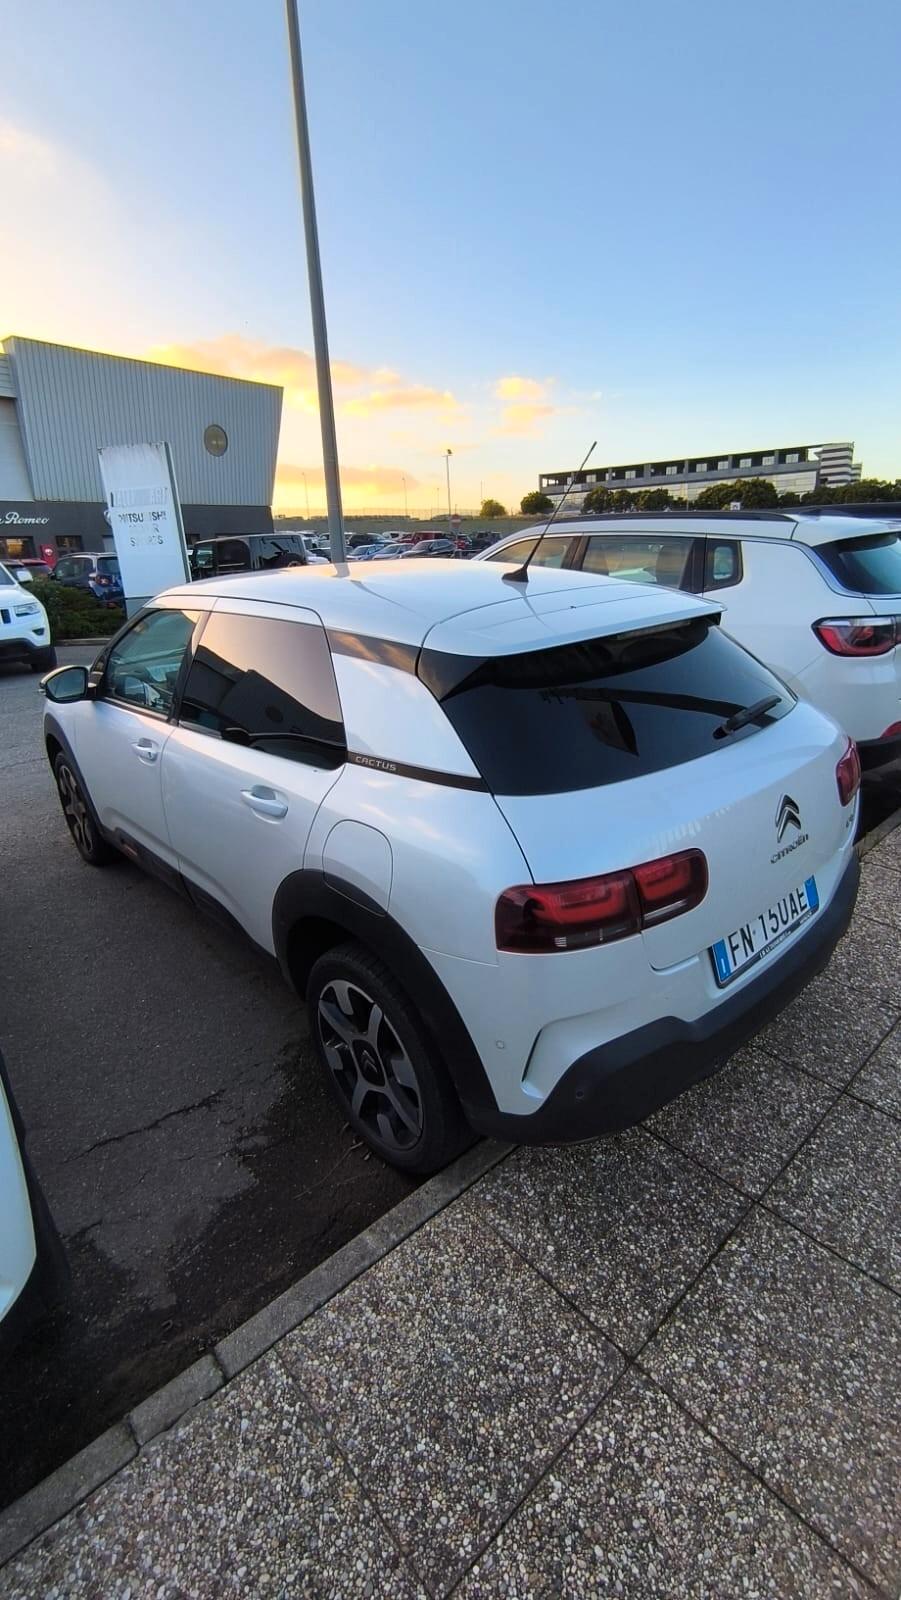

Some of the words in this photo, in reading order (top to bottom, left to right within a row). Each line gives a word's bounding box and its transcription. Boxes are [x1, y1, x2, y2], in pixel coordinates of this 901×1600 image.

[5, 511, 49, 524] Romeo
[355, 756, 397, 771] CACTUS
[728, 924, 755, 967] FN
